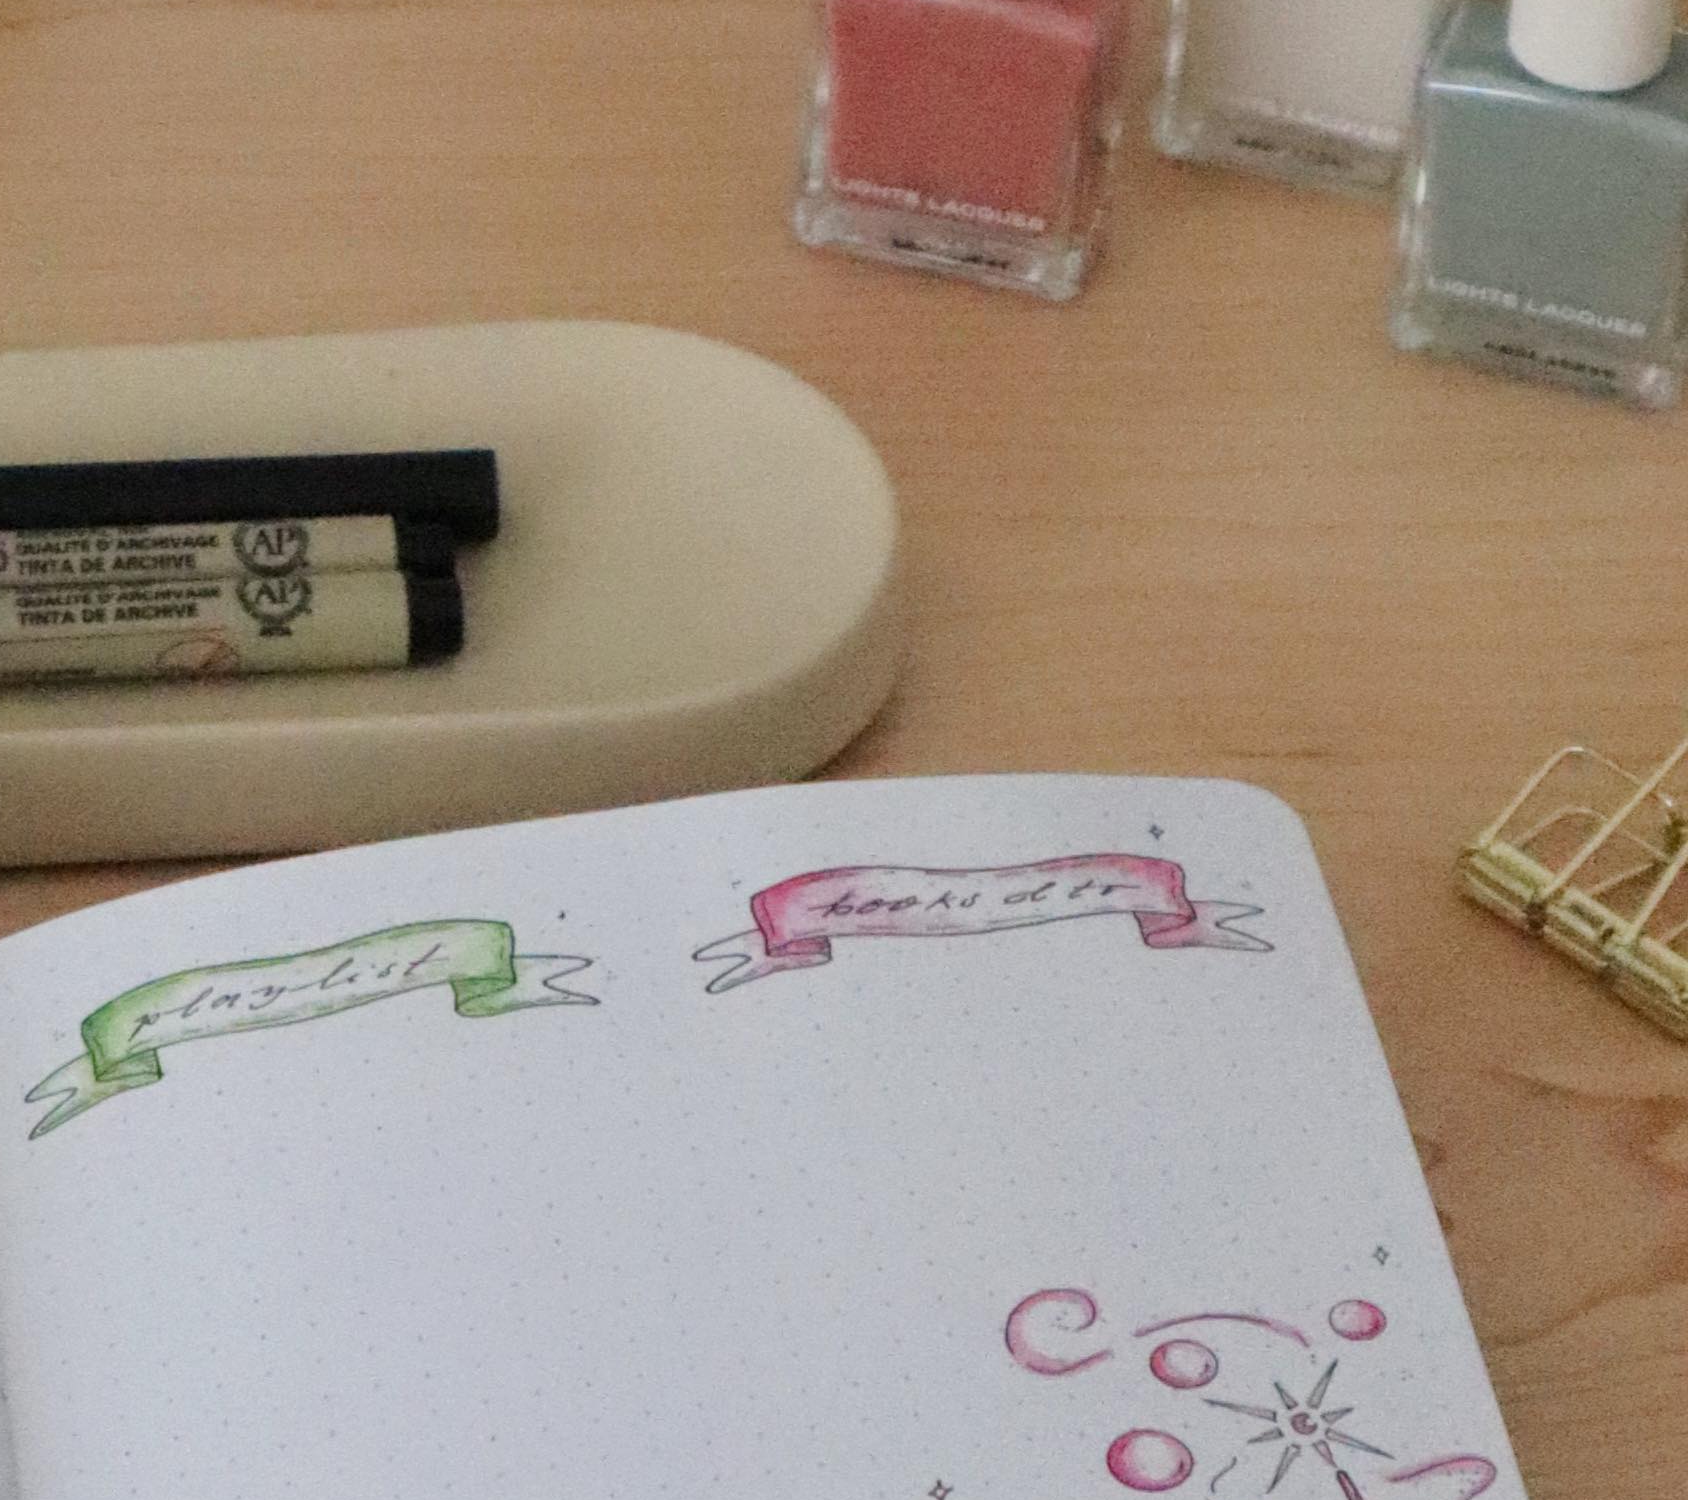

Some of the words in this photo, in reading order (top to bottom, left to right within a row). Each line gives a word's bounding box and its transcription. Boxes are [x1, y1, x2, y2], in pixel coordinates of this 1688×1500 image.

[927, 198, 1046, 232] LACQUER
[1526, 298, 1647, 338] LACQUER
[17, 559, 74, 576] TINTA
[80, 556, 106, 573] DE
[112, 553, 197, 571] ARCHIVE
[18, 609, 75, 627] TINTA
[81, 607, 107, 624] DE
[114, 603, 200, 621] ARCHIVE
[127, 943, 450, 1042] playlist
